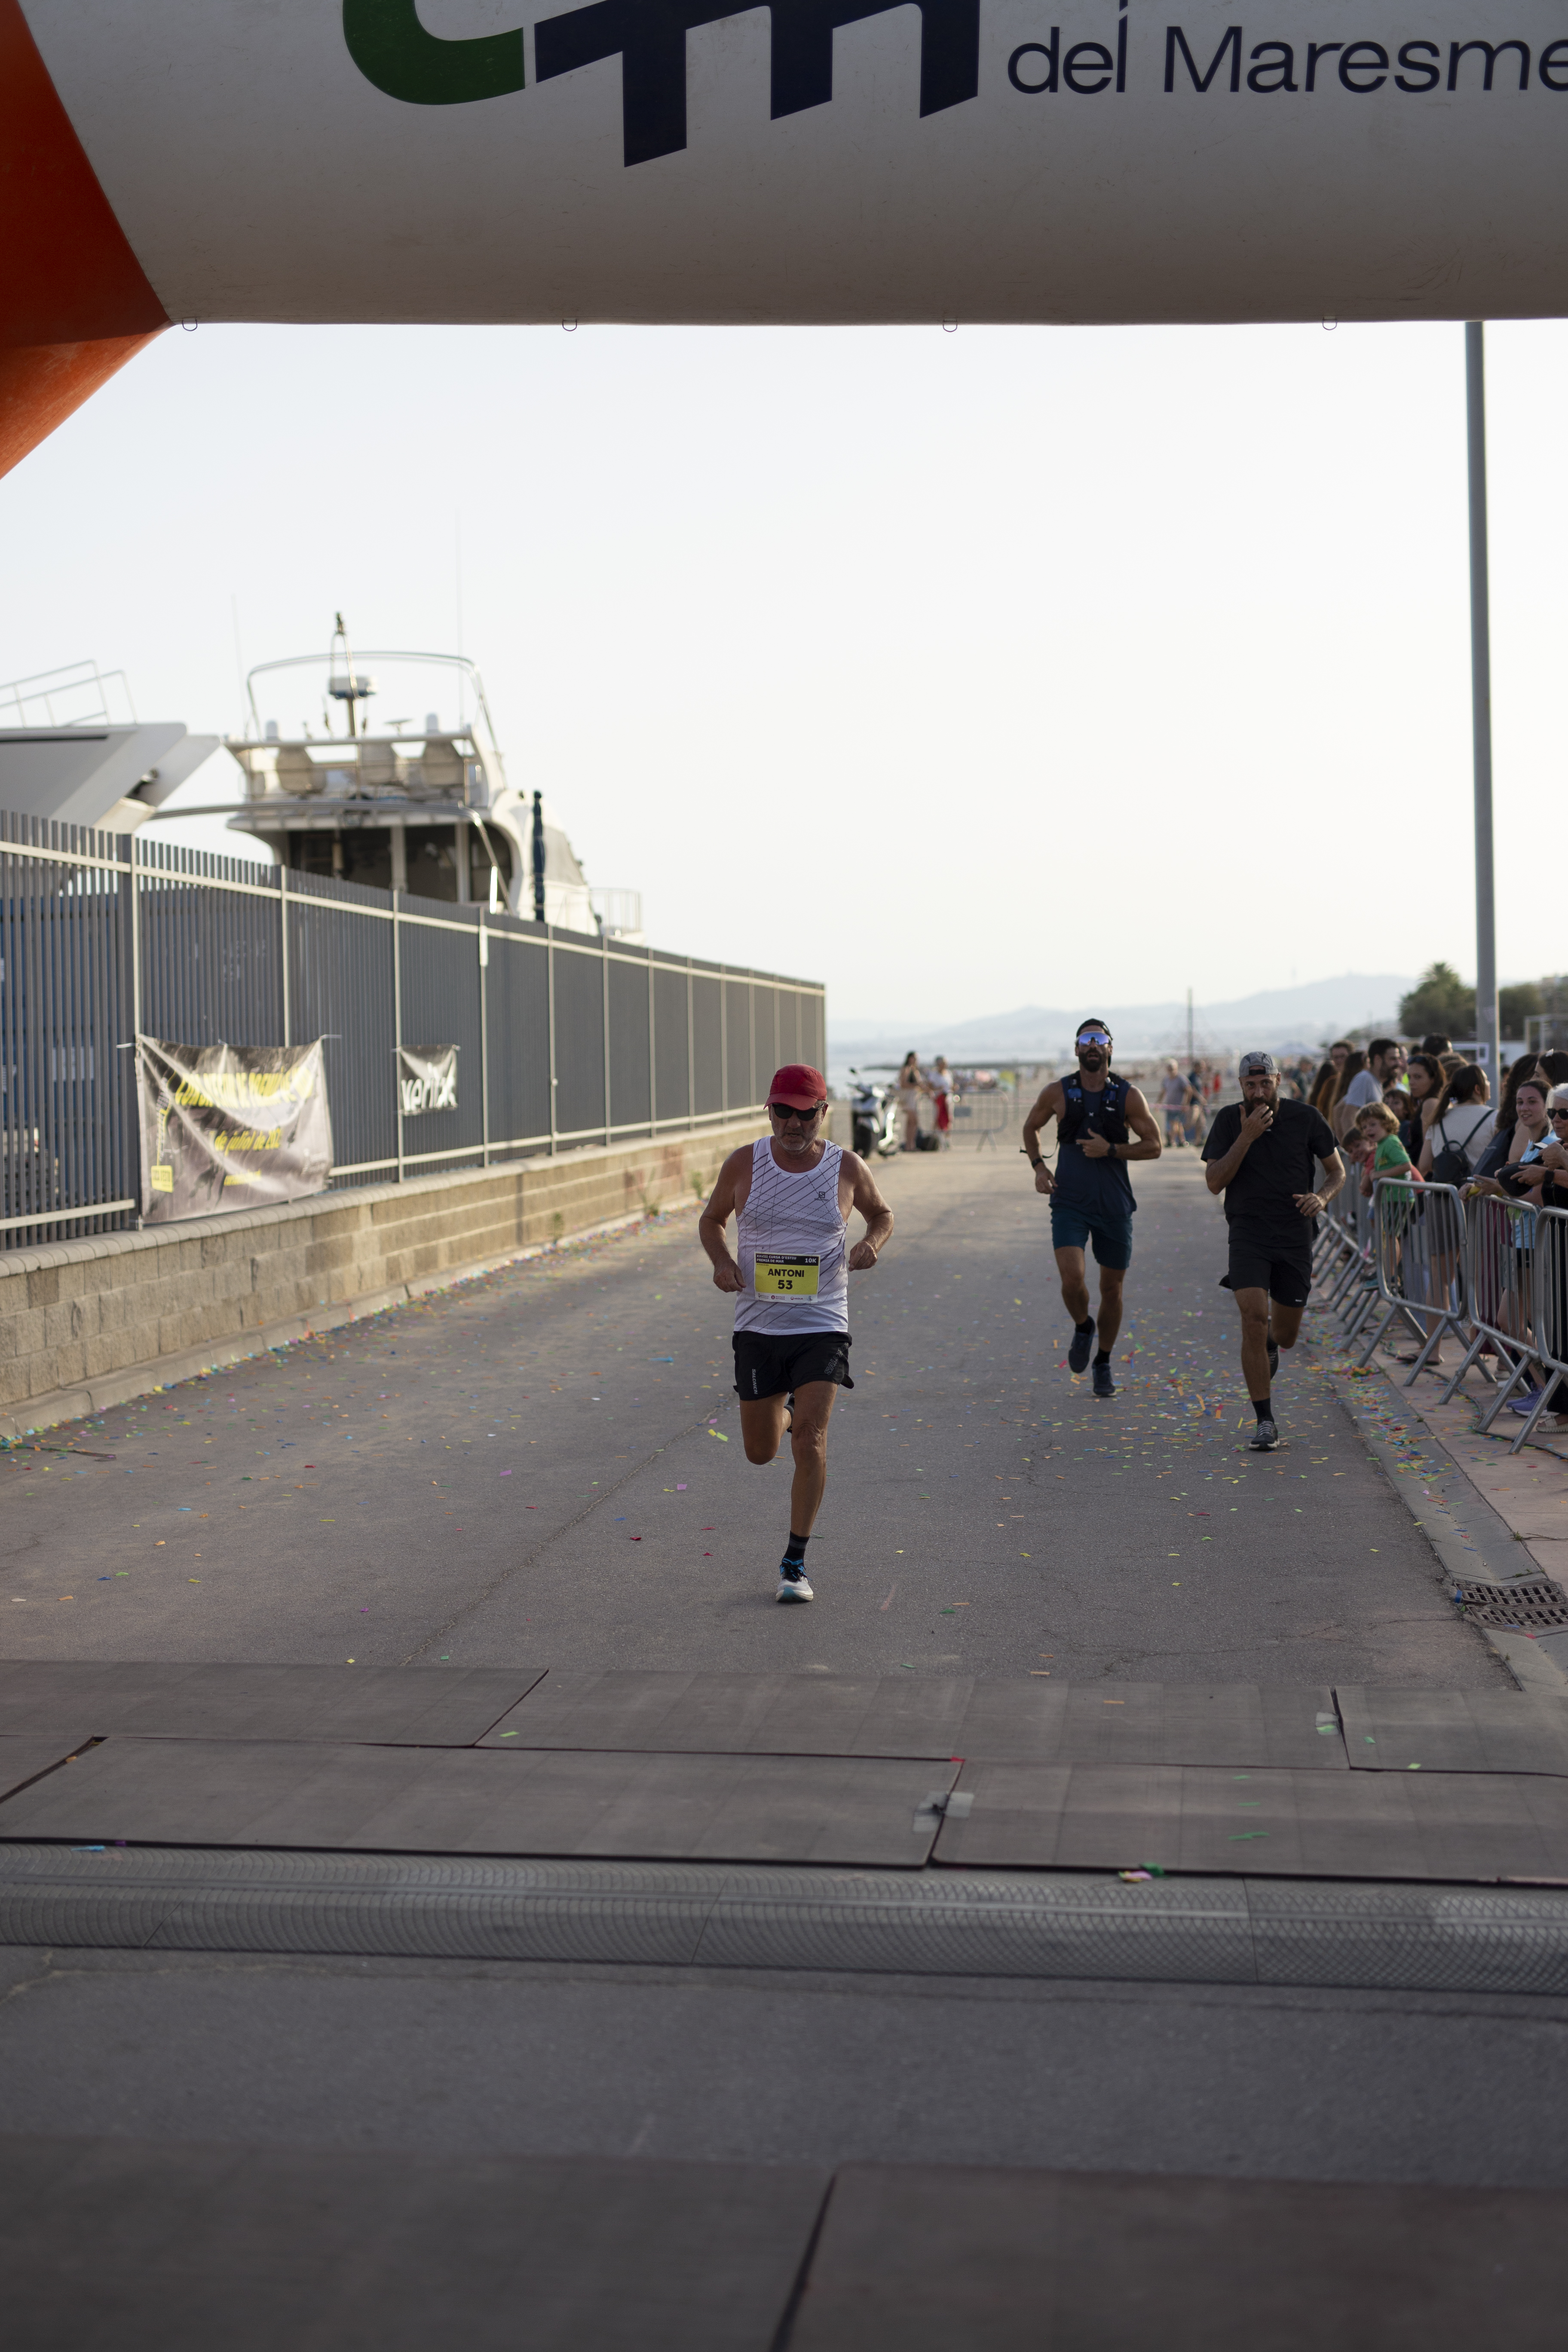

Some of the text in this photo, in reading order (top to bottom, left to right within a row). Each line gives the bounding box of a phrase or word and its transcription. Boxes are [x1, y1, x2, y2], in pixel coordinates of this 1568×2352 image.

[1007, 13, 1568, 94] del Maresme
[767, 1268, 805, 1277] ANTONI
[778, 1279, 793, 1290] 53
